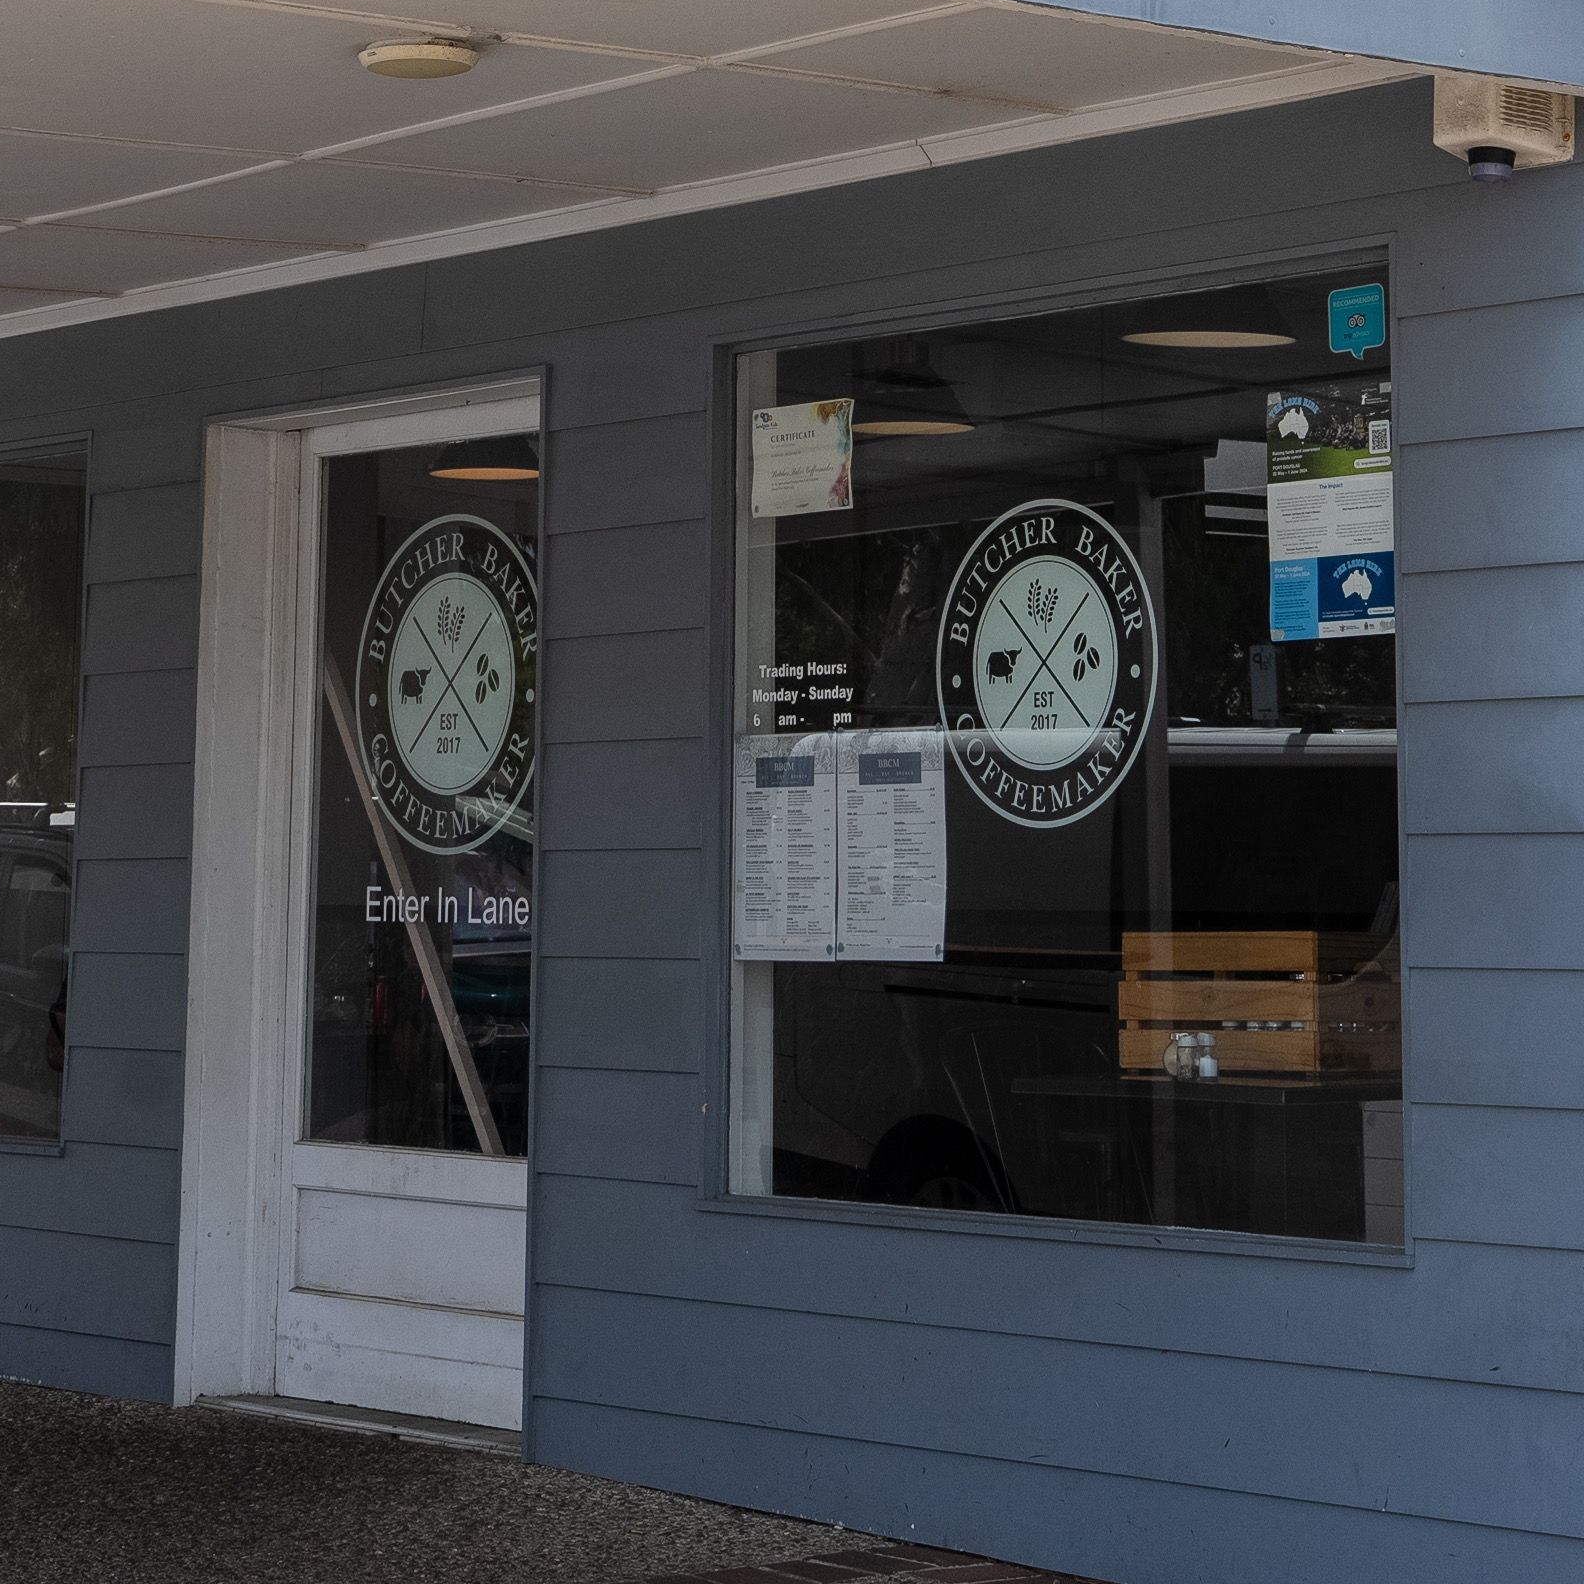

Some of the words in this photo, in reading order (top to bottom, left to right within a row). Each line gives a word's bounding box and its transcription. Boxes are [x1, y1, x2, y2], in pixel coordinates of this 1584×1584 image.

[1333, 294, 1380, 307] RECOMMENDED
[770, 430, 816, 444] CERTIFICATE
[950, 517, 1057, 646] BUTCHER
[1075, 525, 1143, 640] BAKER
[368, 532, 466, 665] BUTCHER
[480, 543, 537, 663] BAKER
[759, 664, 804, 680] Trading
[807, 662, 847, 676] Hours:
[752, 688, 798, 704] Monday
[809, 685, 854, 702] Sunday
[1034, 691, 1054, 708] EST
[440, 713, 459, 731] EST
[753, 713, 761, 727] 6
[778, 714, 797, 726] am
[833, 712, 852, 727] pm
[1031, 713, 1058, 731] 2017
[436, 736, 461, 755] 2017
[878, 758, 901, 768] BBCM
[956, 707, 1136, 814] COFFEEMAKER
[372, 732, 530, 839] COFFEEMAKER
[365, 886, 430, 923] Enter
[437, 886, 458, 924] In
[468, 887, 530, 925] Lane
